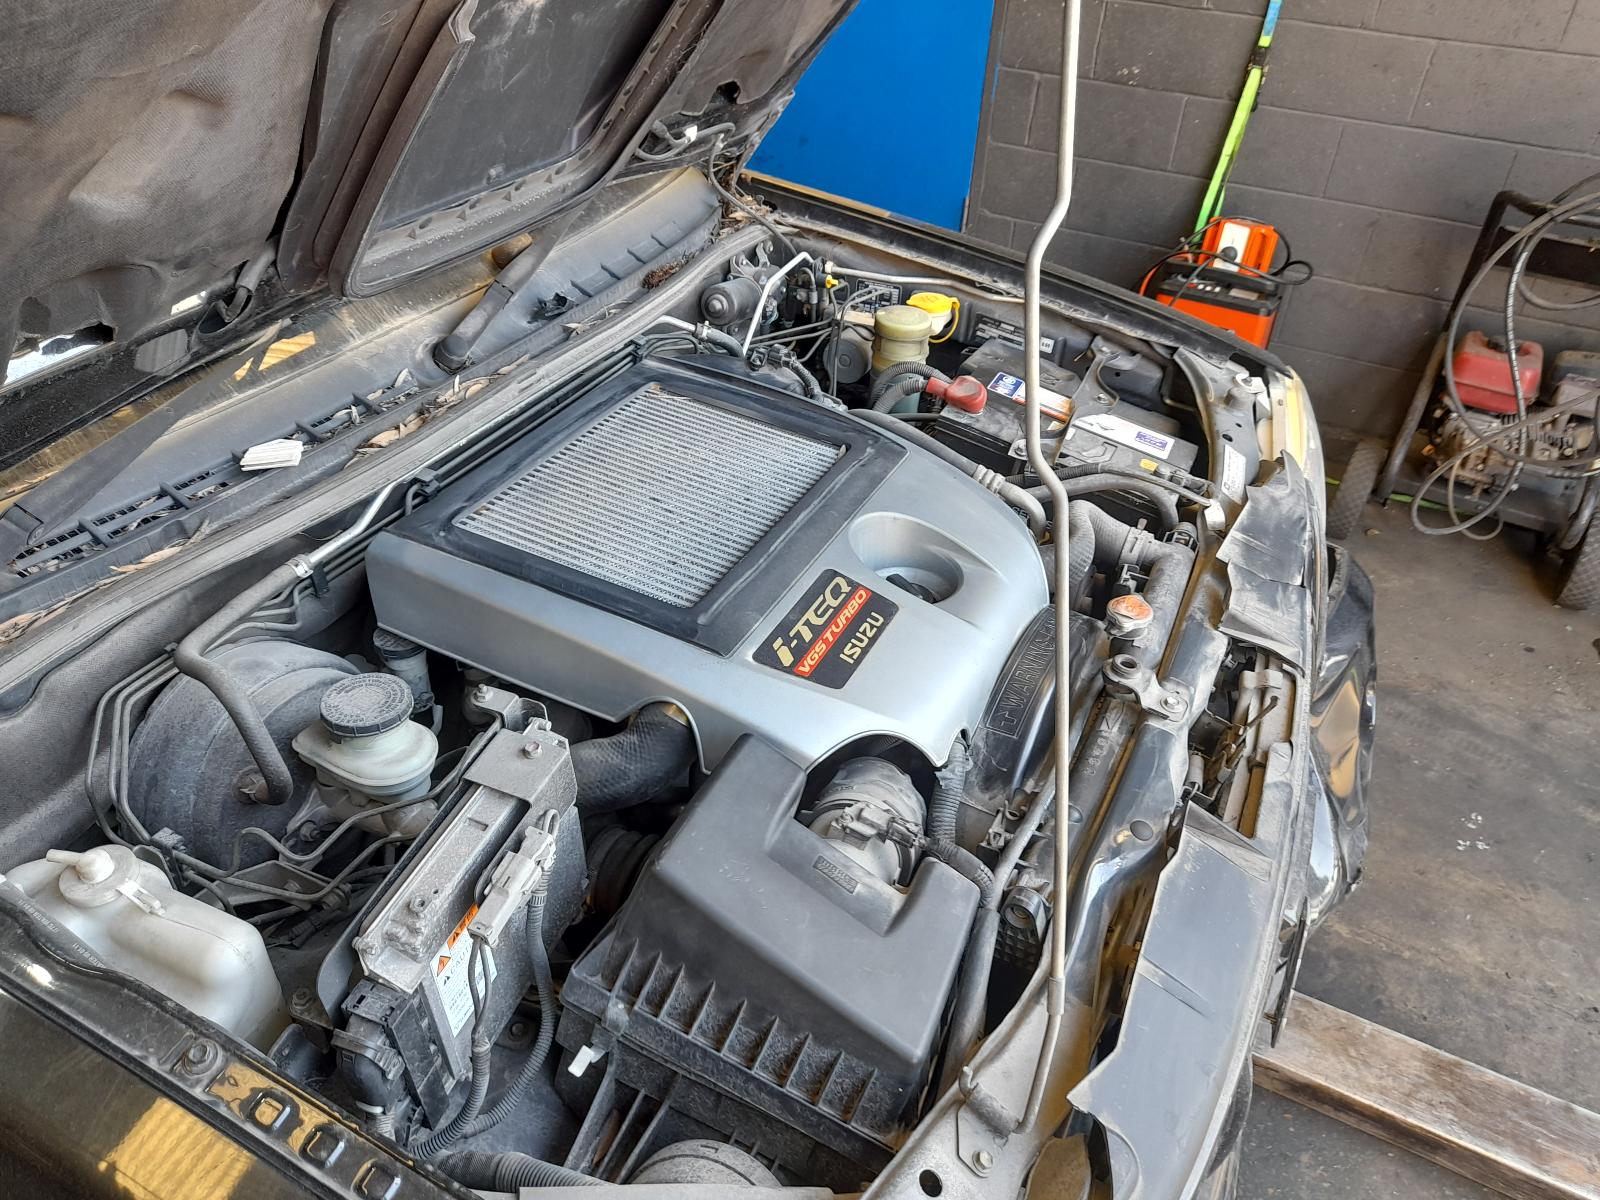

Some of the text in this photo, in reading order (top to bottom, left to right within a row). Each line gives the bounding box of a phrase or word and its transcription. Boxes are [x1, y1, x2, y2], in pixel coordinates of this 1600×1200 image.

[798, 589, 867, 673] VGS TURBO
[839, 611, 885, 664] ISUZU
